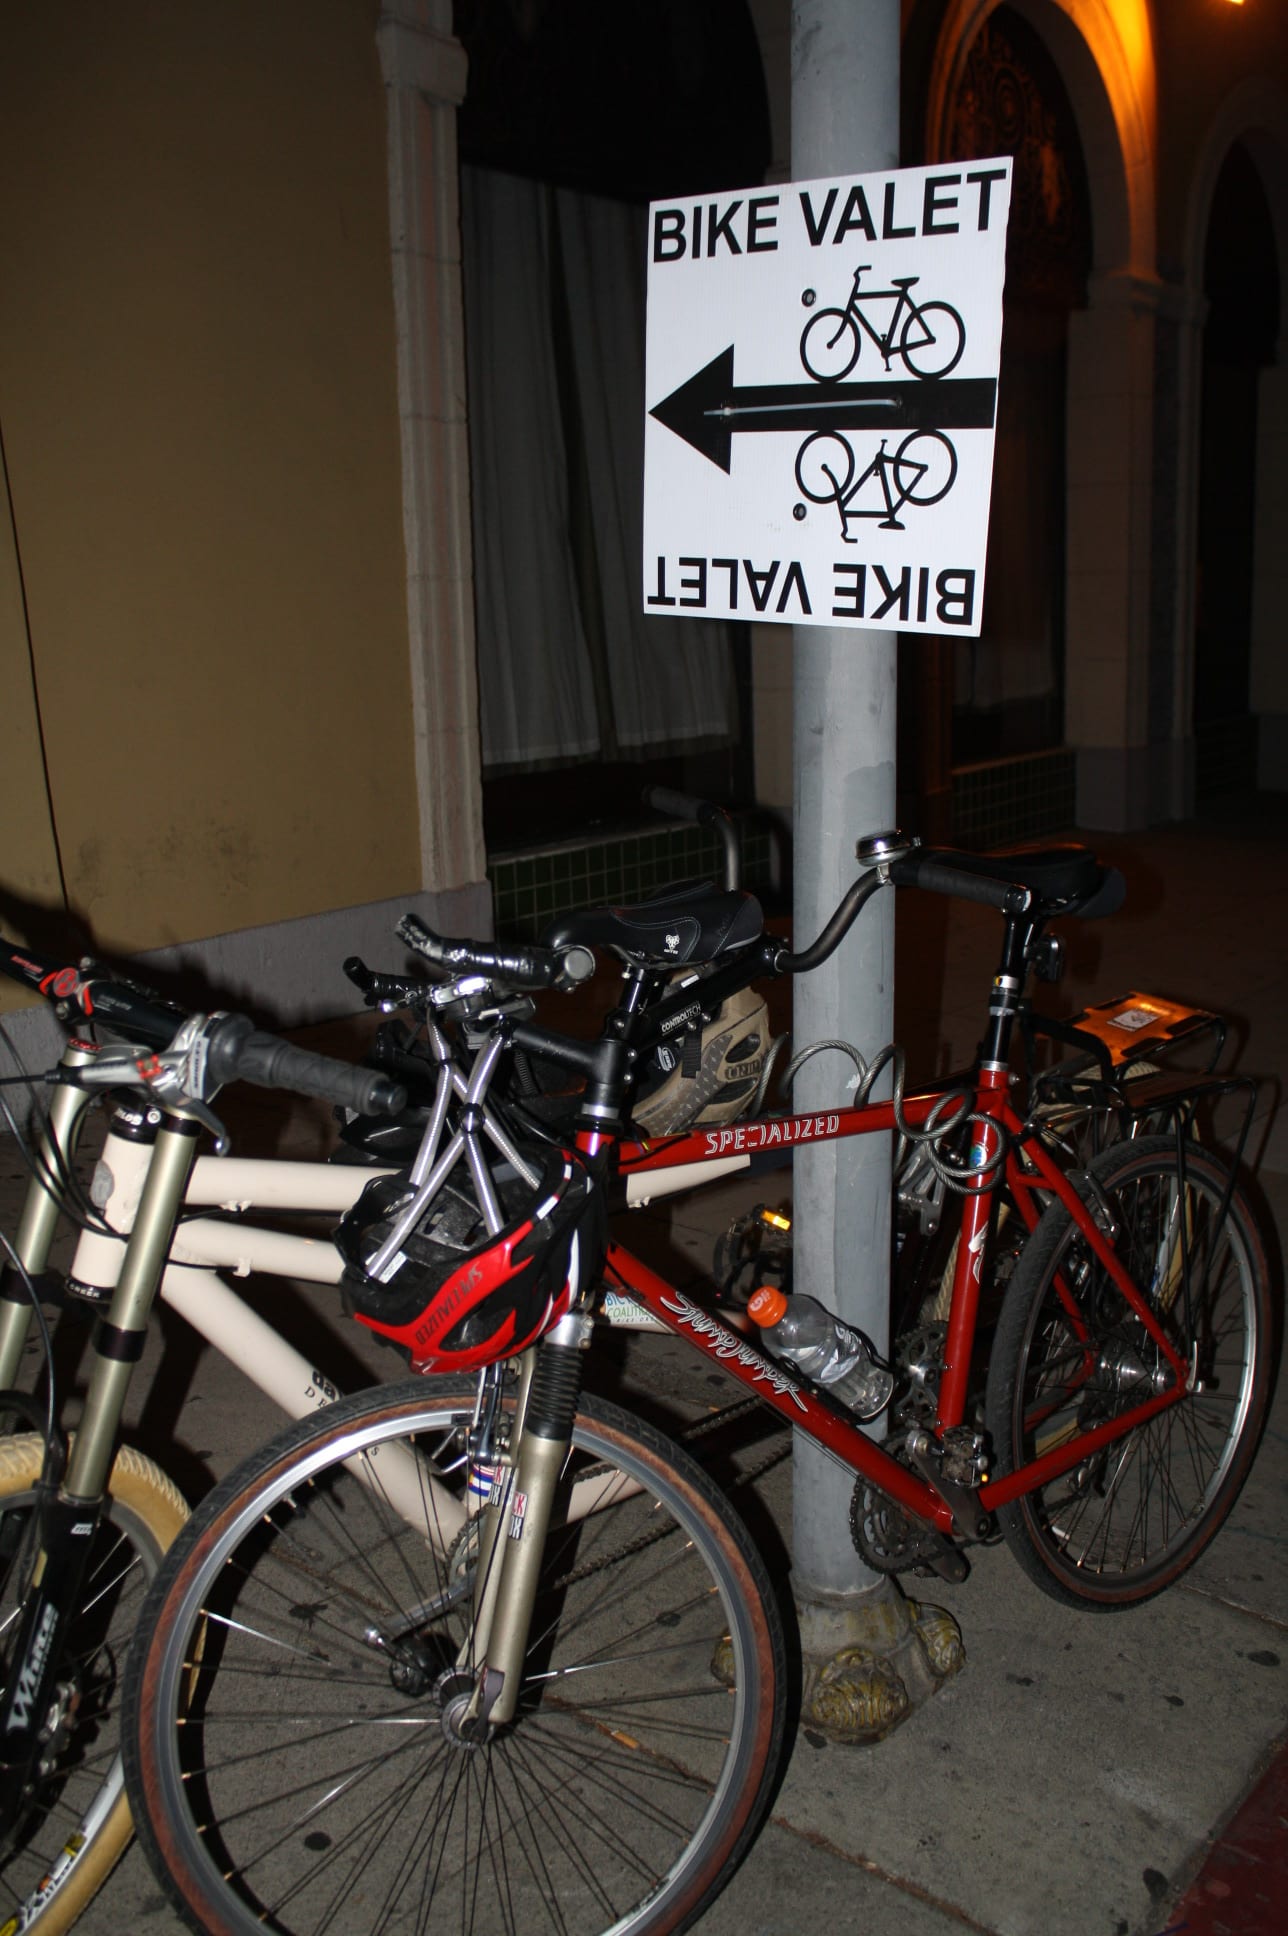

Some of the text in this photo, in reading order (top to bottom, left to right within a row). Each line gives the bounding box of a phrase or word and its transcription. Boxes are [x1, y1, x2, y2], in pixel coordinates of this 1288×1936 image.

[653, 169, 1007, 263] BIKE VALET
[647, 556, 976, 626] BIKE VALET
[704, 1114, 840, 1155] SPECIALIZED
[7, 1602, 55, 1729] White
